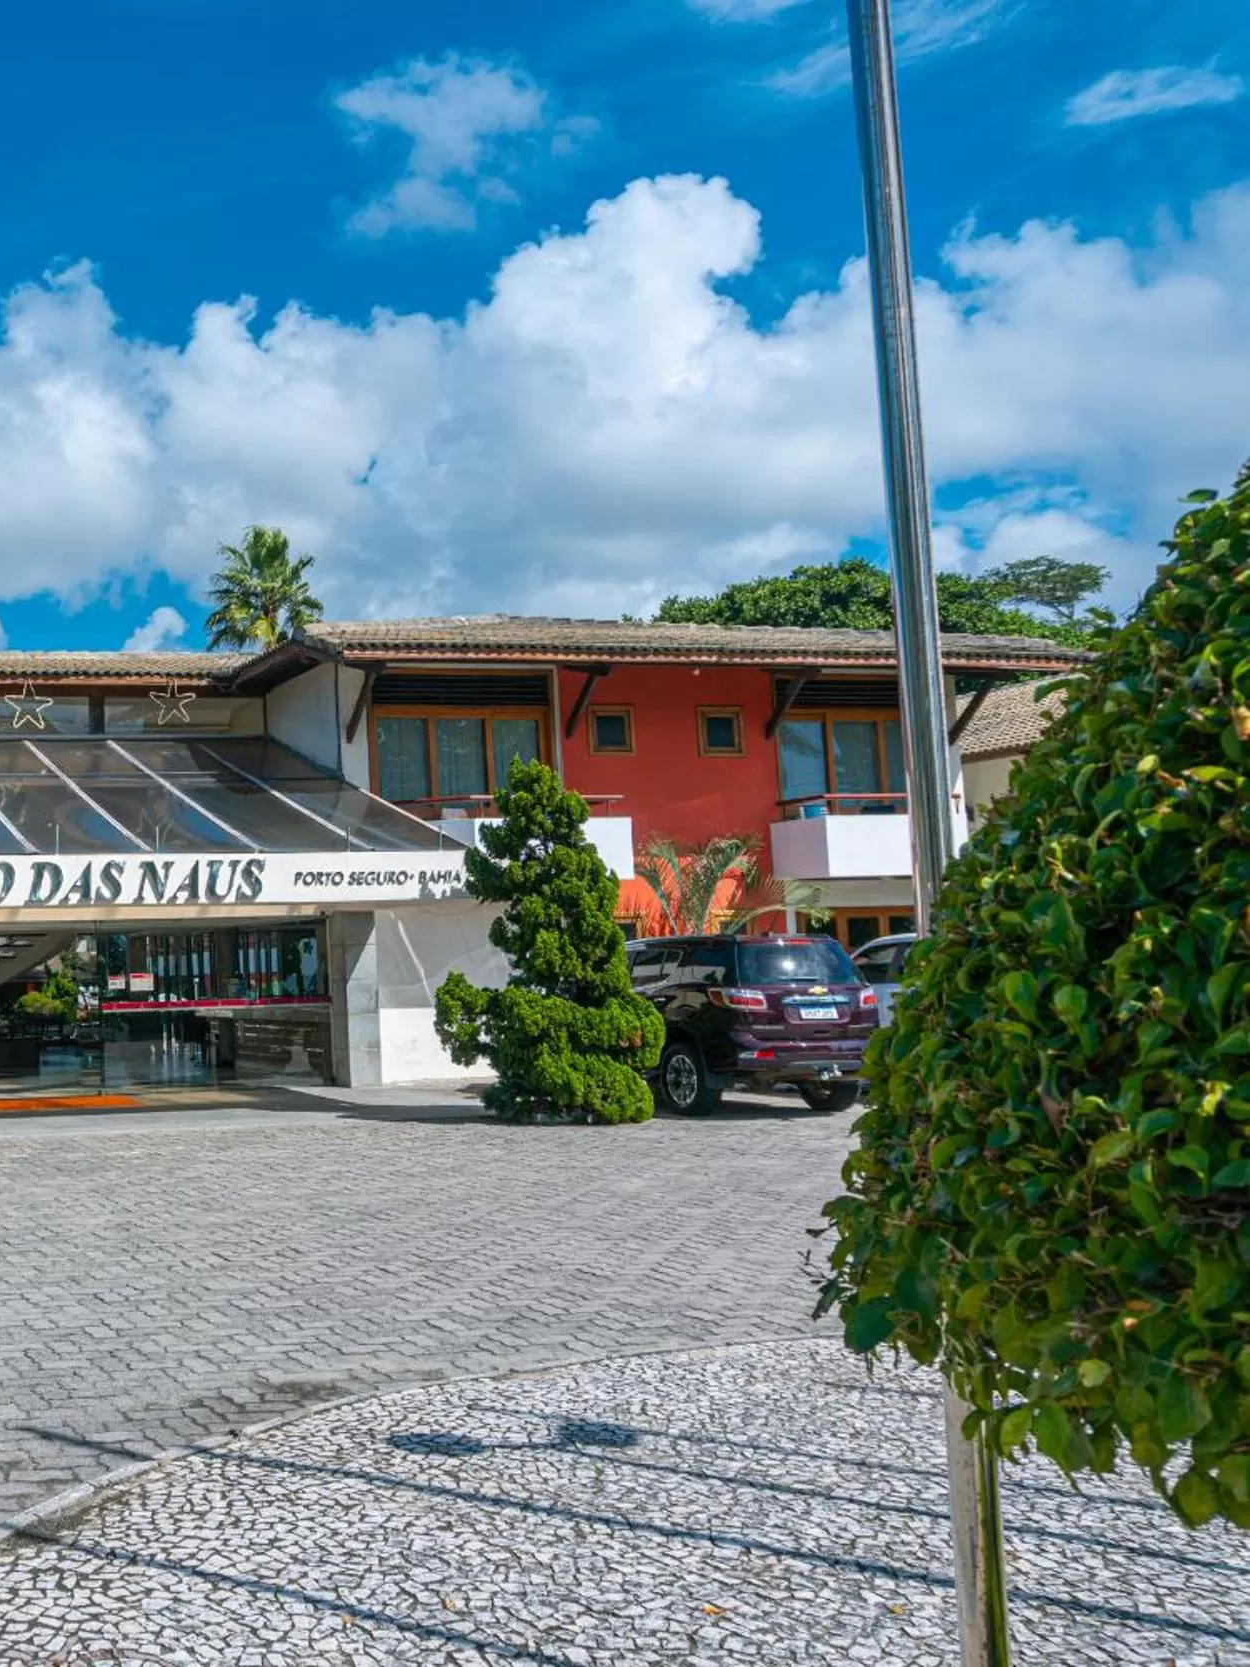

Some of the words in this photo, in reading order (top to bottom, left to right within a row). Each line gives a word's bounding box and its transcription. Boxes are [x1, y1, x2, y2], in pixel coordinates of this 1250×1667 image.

[22, 859, 127, 906] DAS
[132, 857, 267, 905] NAUS
[293, 871, 345, 887] PORTO
[418, 869, 462, 885] BAHIA
